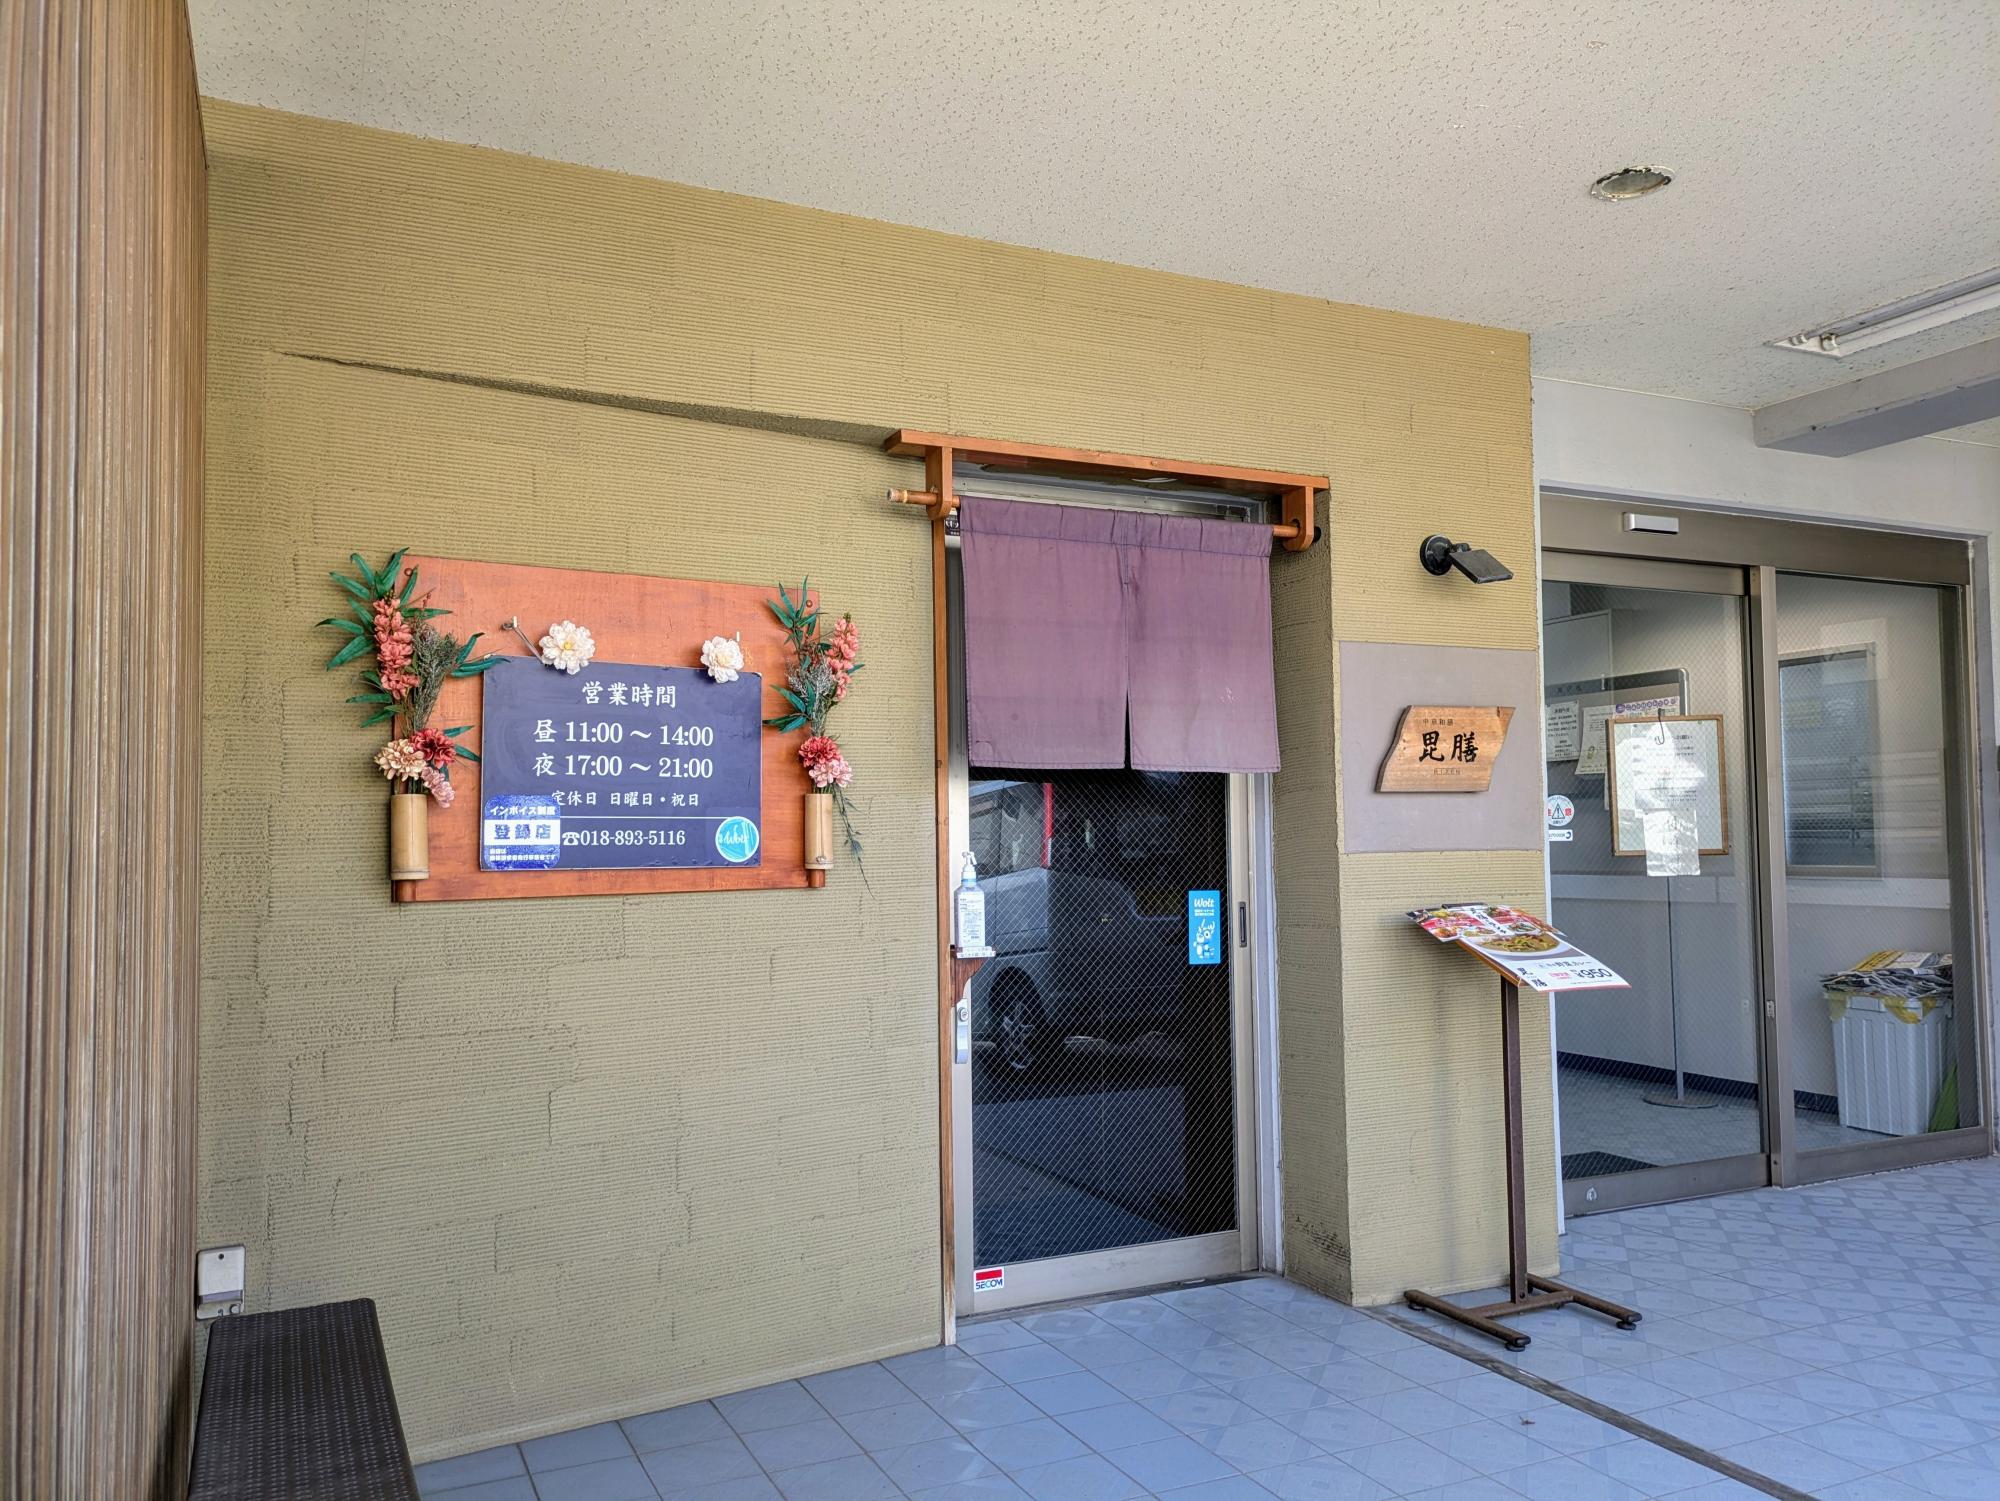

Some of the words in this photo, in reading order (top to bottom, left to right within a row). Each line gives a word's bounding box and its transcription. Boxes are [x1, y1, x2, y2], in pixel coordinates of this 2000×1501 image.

[581, 680, 677, 708] 営業時間
[532, 719, 557, 744] 昼
[565, 721, 623, 744] 11:00
[660, 725, 714, 747] 14:00
[1418, 730, 1479, 763] 毘膳
[532, 753, 557, 777] 夜
[565, 754, 623, 777] 17:00
[659, 757, 713, 778] 21:00
[551, 790, 597, 807] 定休日
[610, 791, 699, 808] 日曜日・祝日
[493, 823, 551, 840] 登録店
[580, 829, 686, 847] 018-893-5116
[1194, 898, 1215, 908] Wolt
[975, 1278, 1003, 1290] SECOM
